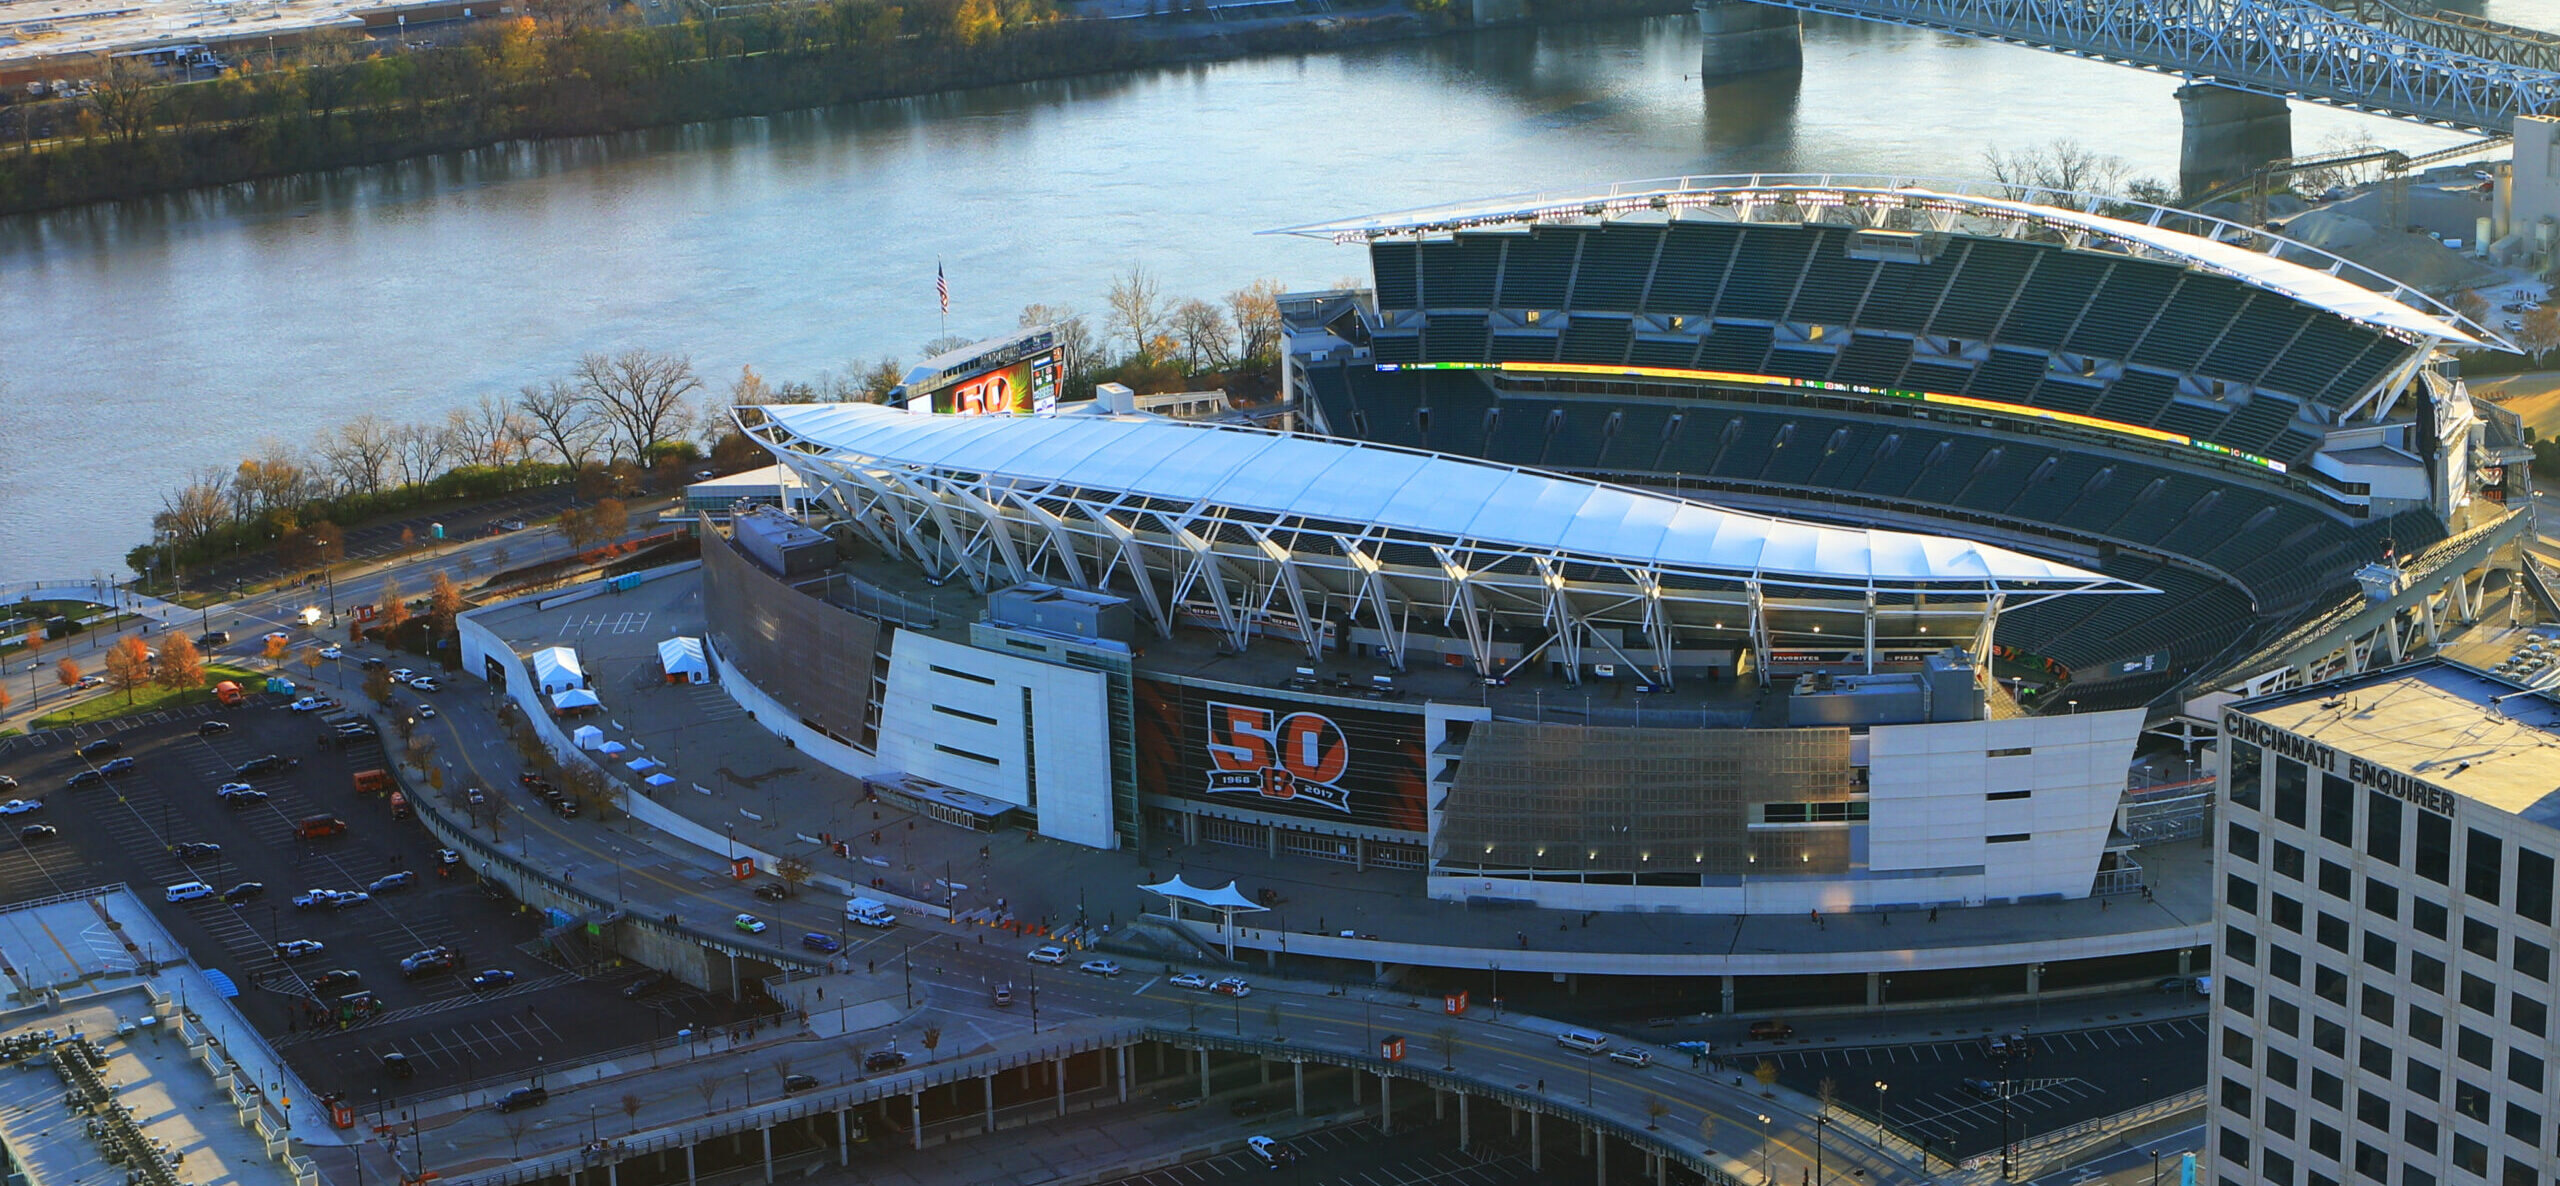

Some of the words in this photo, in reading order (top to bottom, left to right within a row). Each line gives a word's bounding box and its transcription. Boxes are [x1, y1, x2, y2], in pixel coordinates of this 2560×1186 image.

[956, 376, 1012, 415] 50
[1206, 700, 1349, 785] 50
[1222, 776, 1250, 784] 1968
[2224, 712, 2335, 772] CINCINNATI
[2350, 757, 2456, 818] ENQUIRER
[1304, 784, 1334, 799] 2017
